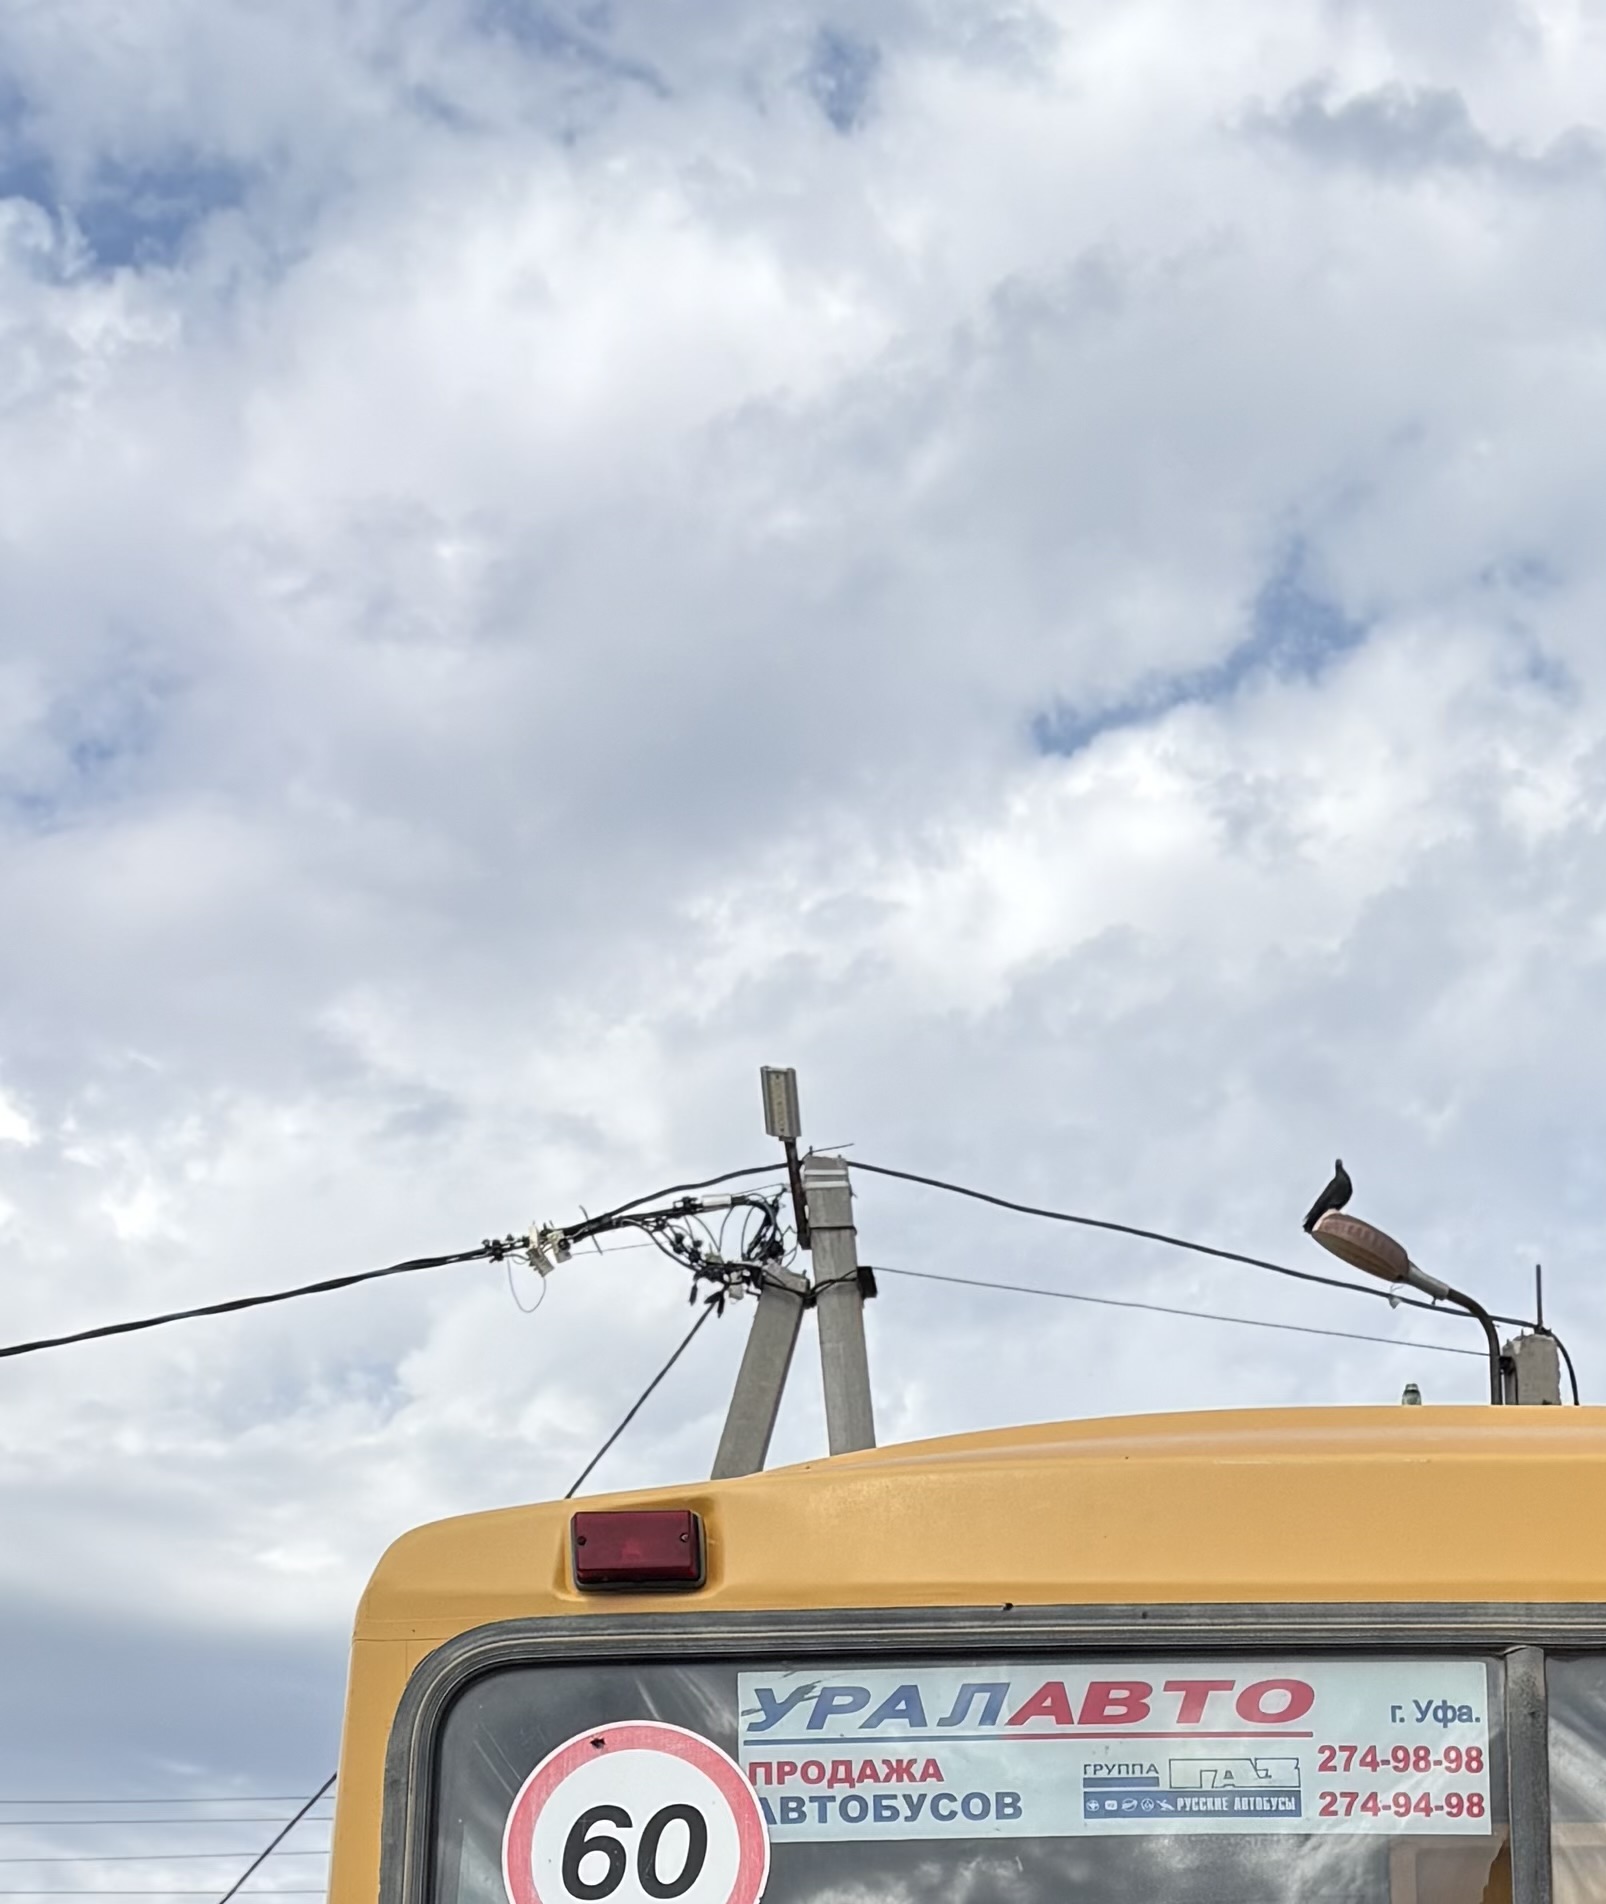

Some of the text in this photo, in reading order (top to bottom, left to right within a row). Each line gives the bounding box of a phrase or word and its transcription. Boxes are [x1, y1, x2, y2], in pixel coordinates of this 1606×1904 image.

[746, 1679, 1316, 1732] УРАЛАВТО
[1390, 1699, 1481, 1729] г. Уфа.
[748, 1758, 945, 1789] ПРОДАЖА
[1083, 1763, 1159, 1776] ГРУППА
[1317, 1744, 1484, 1774] 274-98-98
[1176, 1796, 1296, 1811] РУССКИЕ АВТОБУСЫ
[1318, 1791, 1486, 1819] 274-94-98
[561, 1803, 709, 1901] 60
